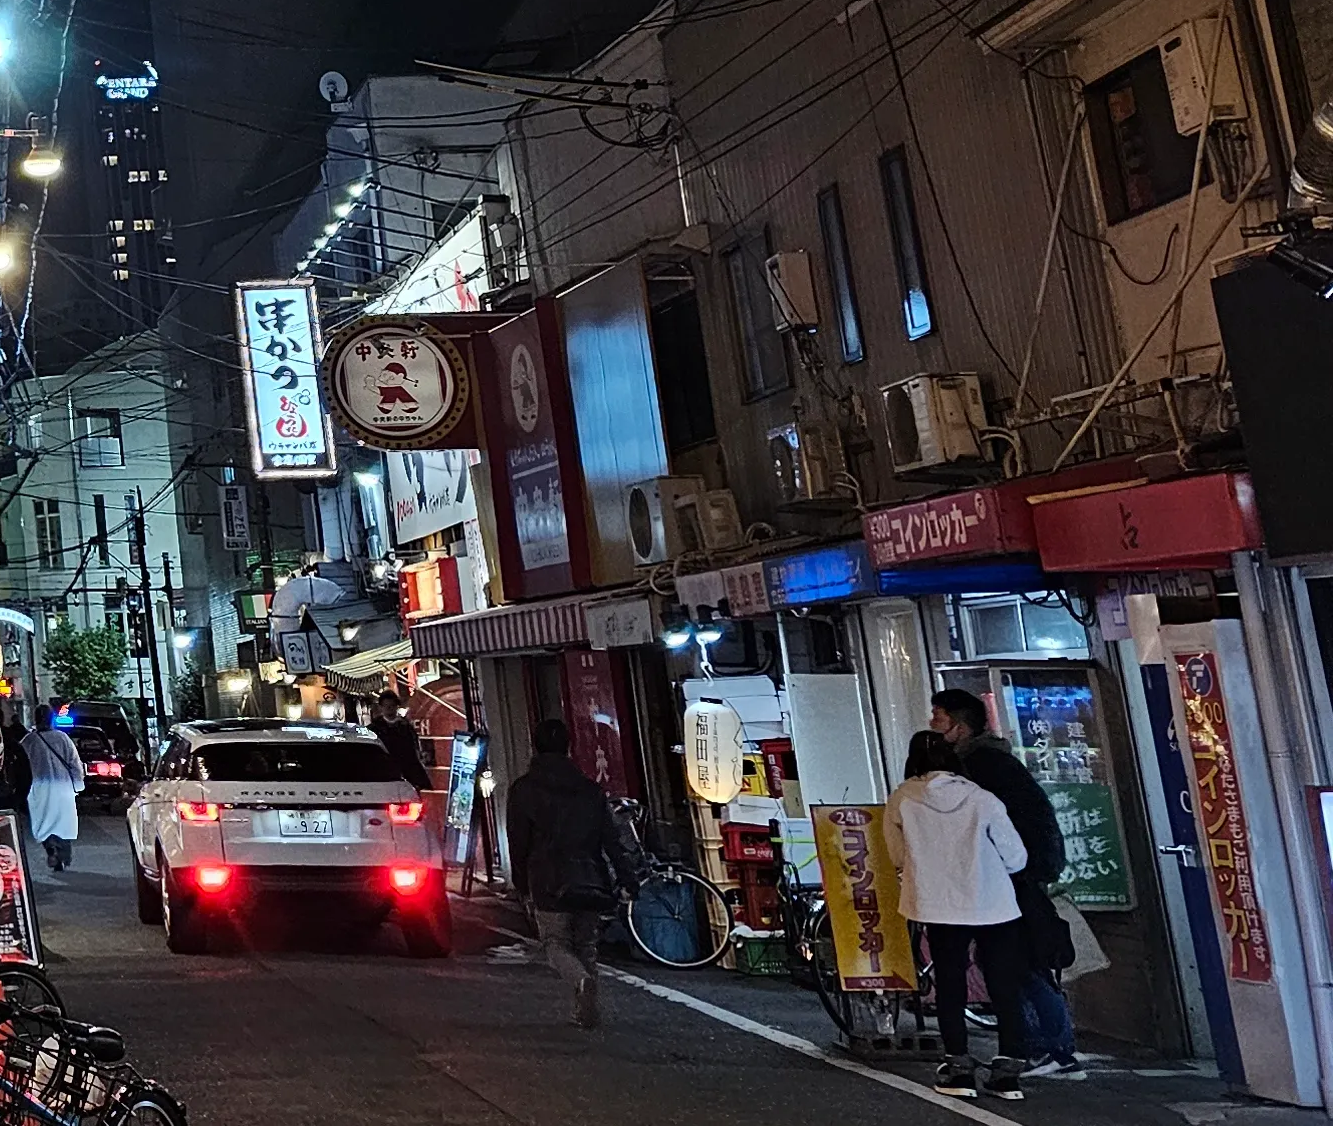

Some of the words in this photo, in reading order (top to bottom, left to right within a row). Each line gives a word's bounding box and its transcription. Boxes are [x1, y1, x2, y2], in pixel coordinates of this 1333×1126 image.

[254, 297, 303, 392] 串かつ
[891, 503, 980, 554] コインロッカー
[842, 828, 885, 973] コインロッカー
[1192, 742, 1250, 973] コインロッカー
